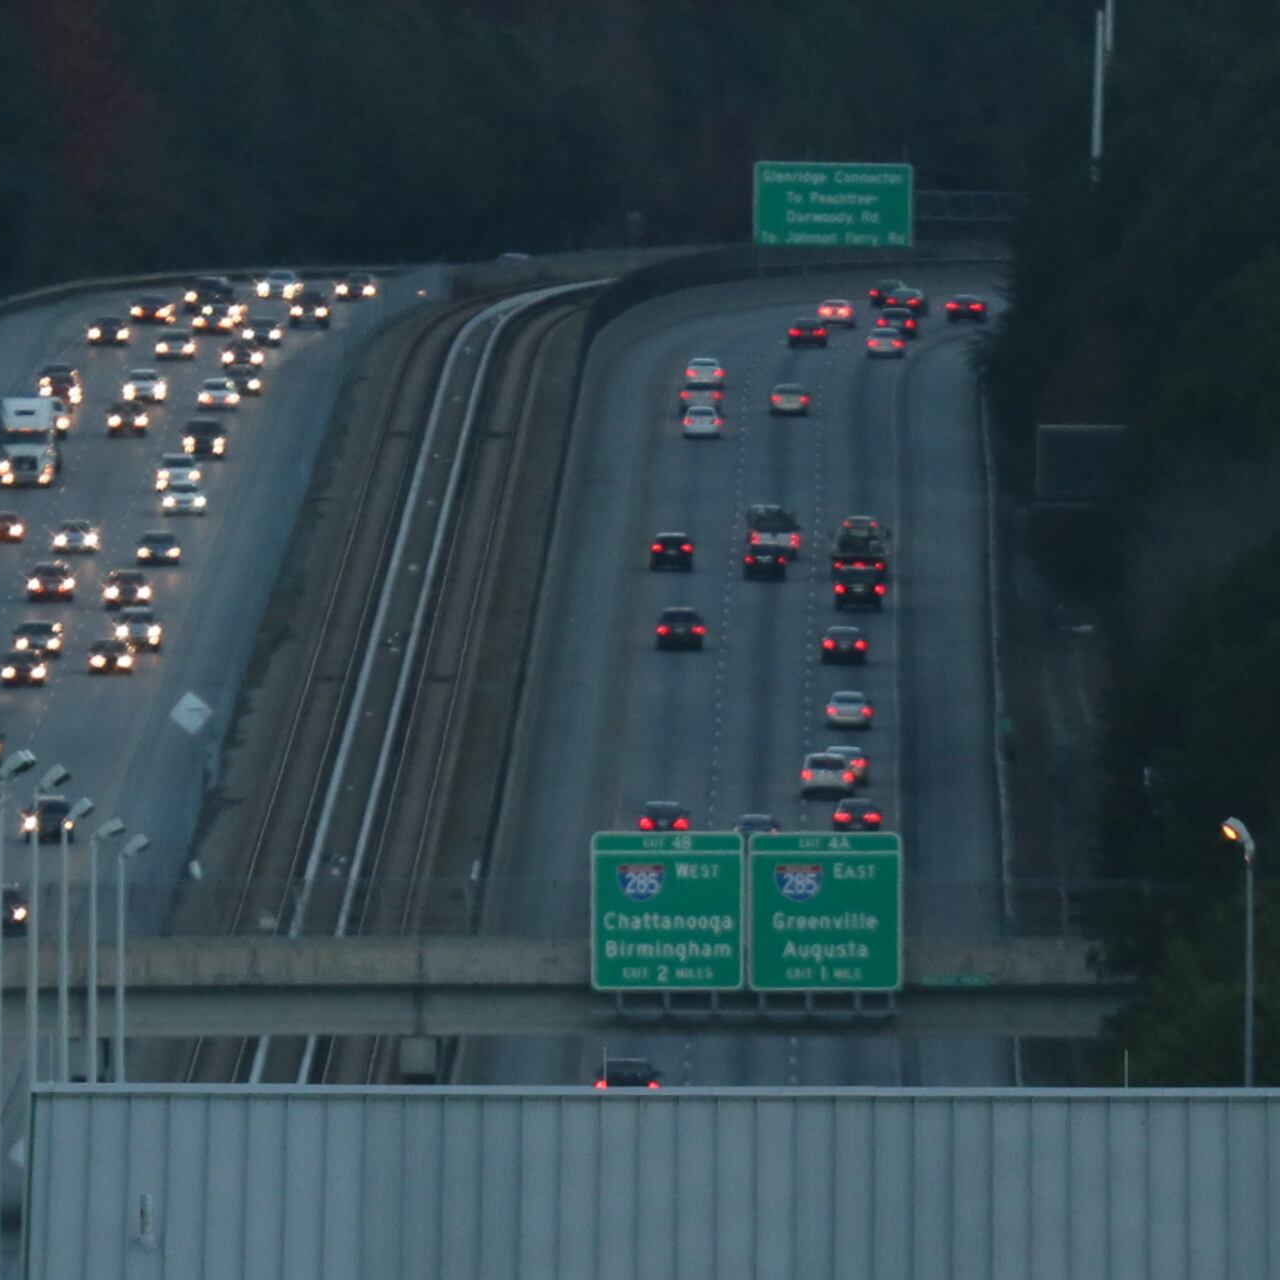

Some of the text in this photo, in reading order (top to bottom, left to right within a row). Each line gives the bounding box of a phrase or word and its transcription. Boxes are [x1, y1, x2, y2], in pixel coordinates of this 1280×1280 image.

[763, 170, 902, 185] Glenridge Connector
[786, 191, 802, 203] To
[786, 210, 879, 225] Dunwoody Rd
[672, 836, 692, 849] 4B
[828, 837, 851, 849] 4A
[625, 863, 720, 894] 285 WEST
[783, 863, 876, 894] 285 EAST
[604, 912, 733, 933] Chattanooga
[772, 912, 879, 930] Greenville
[605, 940, 732, 962] Birmingham
[782, 940, 868, 962] Augusta
[623, 965, 713, 980] EXIT 2 MILES
[786, 967, 812, 979] EXIT
[833, 967, 862, 979] MILE
